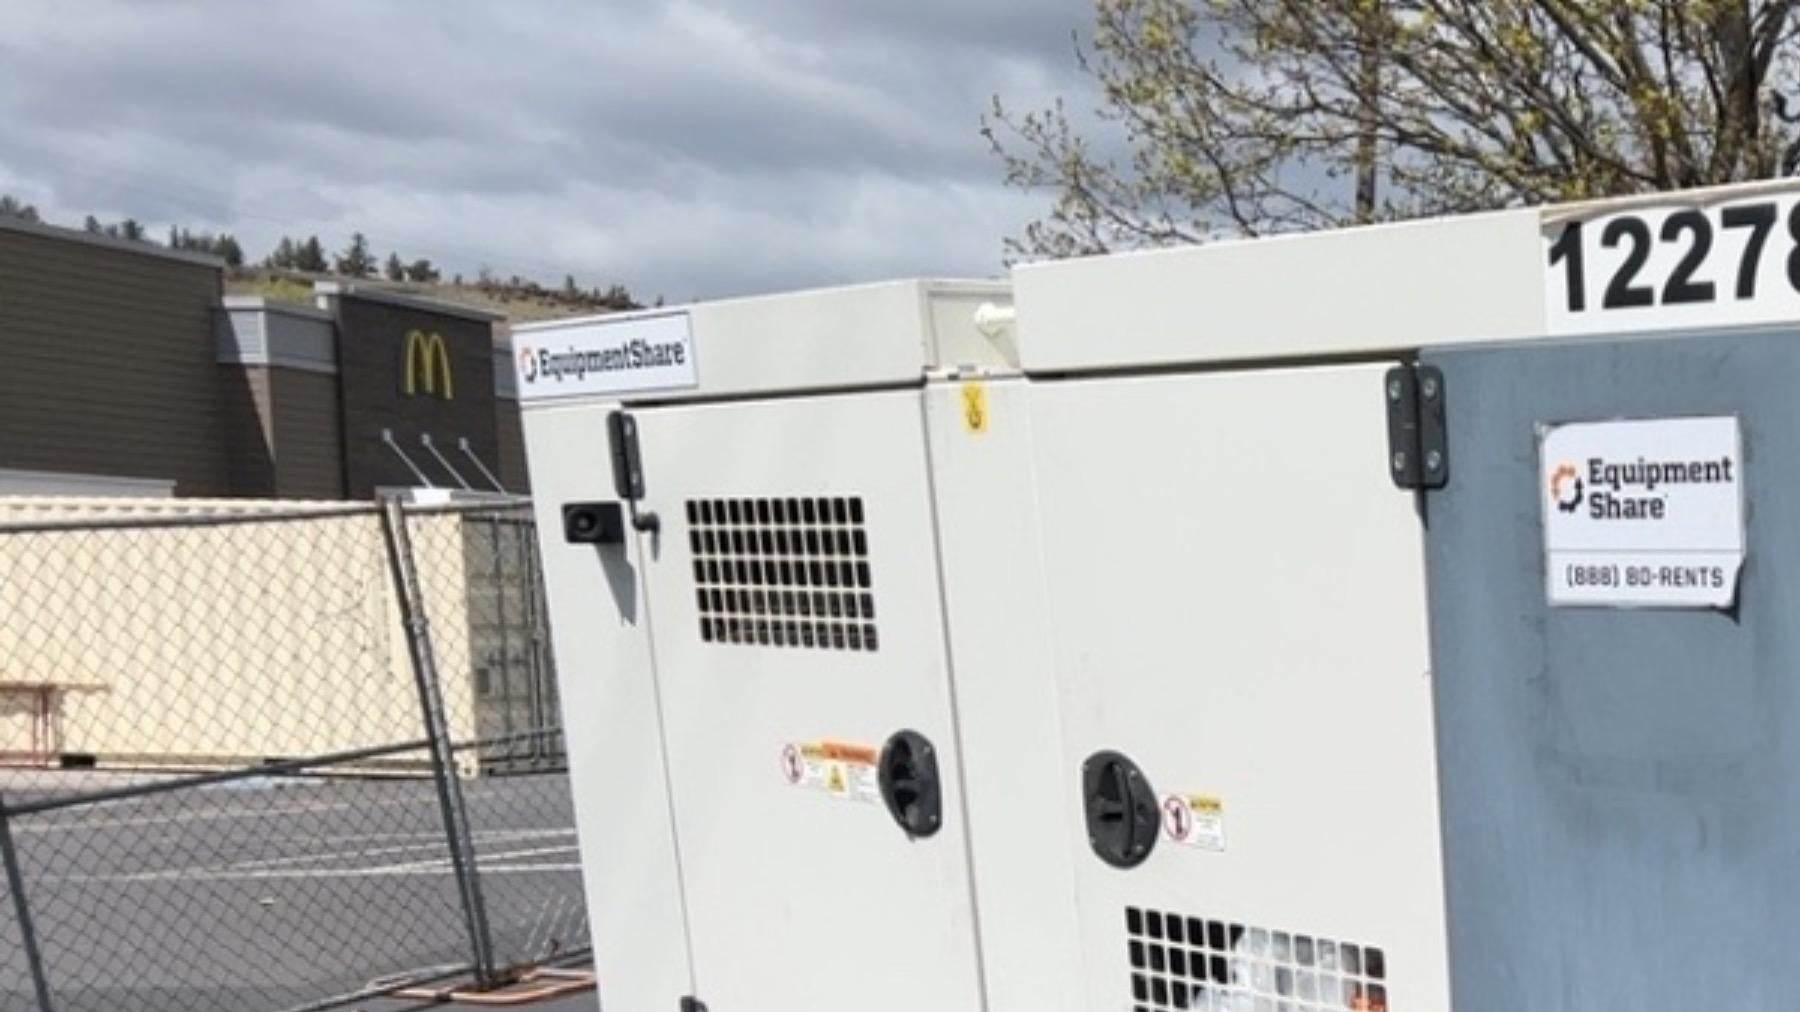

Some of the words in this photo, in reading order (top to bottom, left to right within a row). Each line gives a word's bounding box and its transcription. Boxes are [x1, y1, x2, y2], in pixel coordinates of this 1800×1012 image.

[538, 338, 687, 382] EquipmentShare
[1587, 456, 1733, 491] Equipment
[1588, 491, 1666, 520] Share
[1566, 563, 1620, 589] (888)
